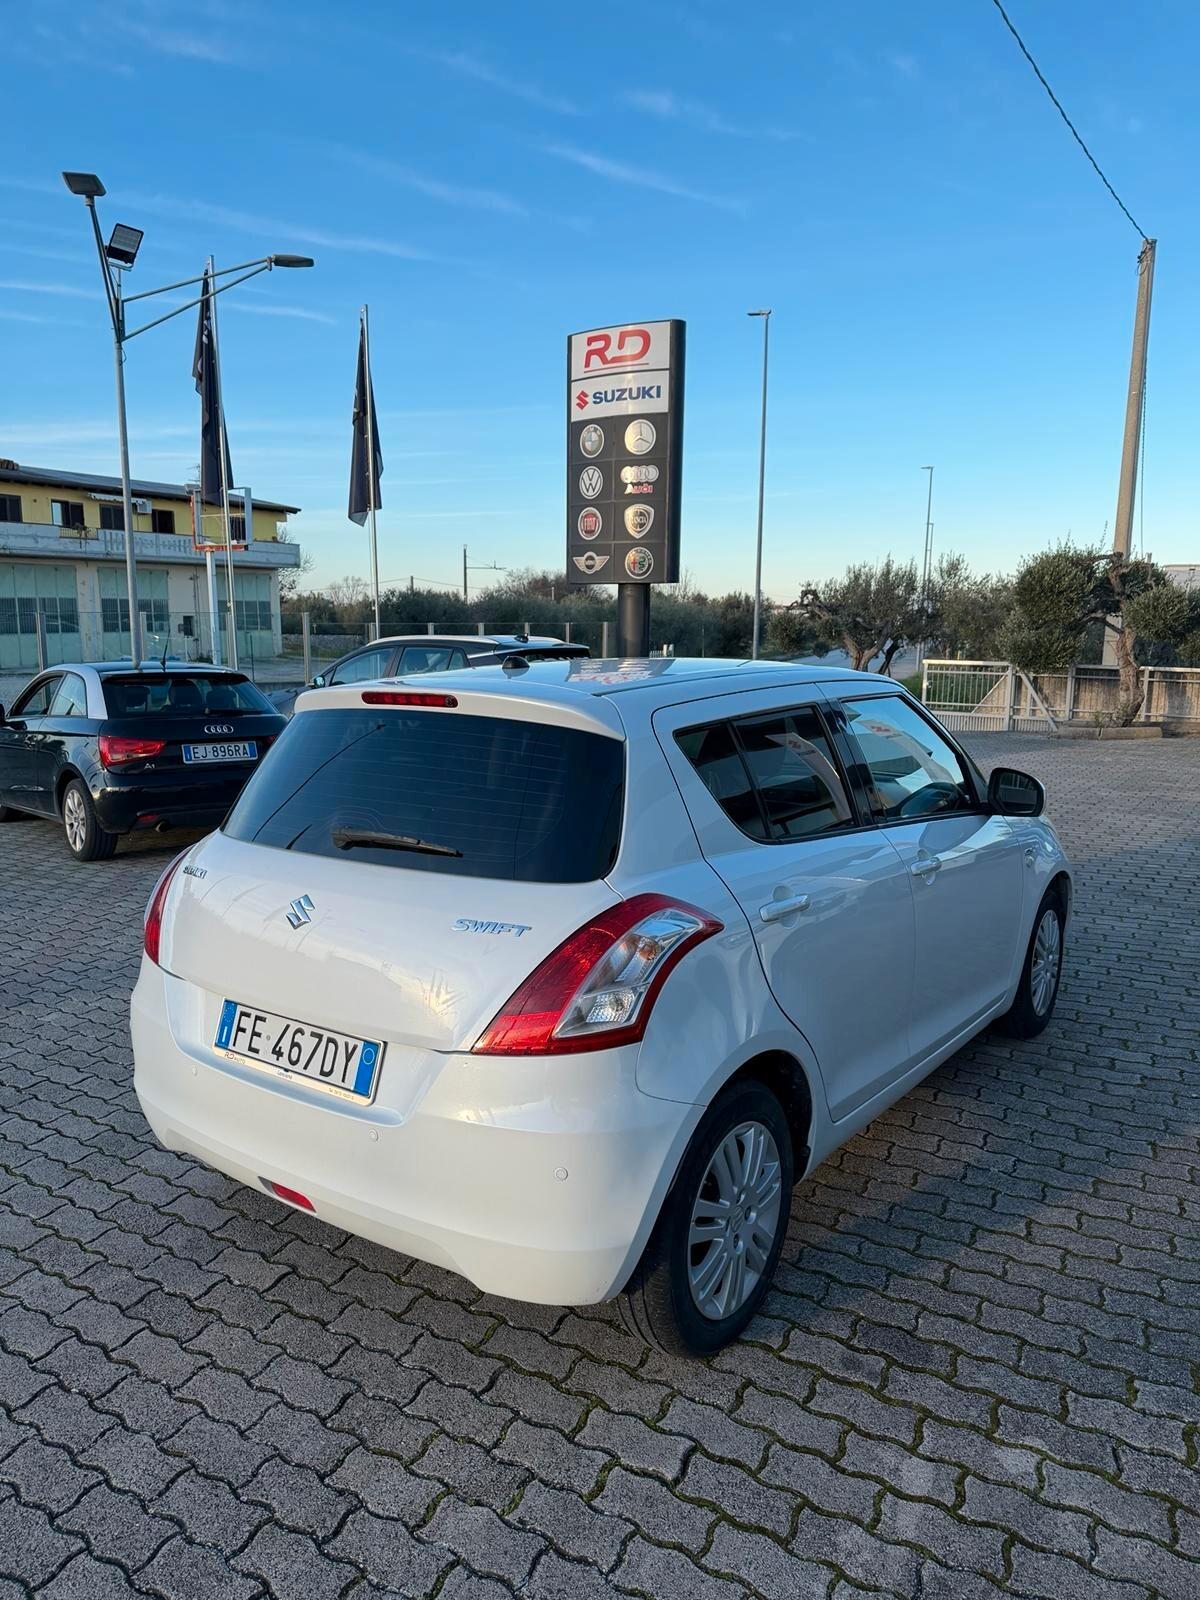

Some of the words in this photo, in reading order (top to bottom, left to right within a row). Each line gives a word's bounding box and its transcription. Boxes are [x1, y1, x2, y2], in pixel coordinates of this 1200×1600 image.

[584, 328, 651, 369] RD
[592, 385, 662, 405] SUZUKI
[211, 744, 249, 758] 896RA
[451, 918, 532, 937] SWIFT
[232, 1010, 267, 1054] FE
[271, 1023, 359, 1084] 467DY
